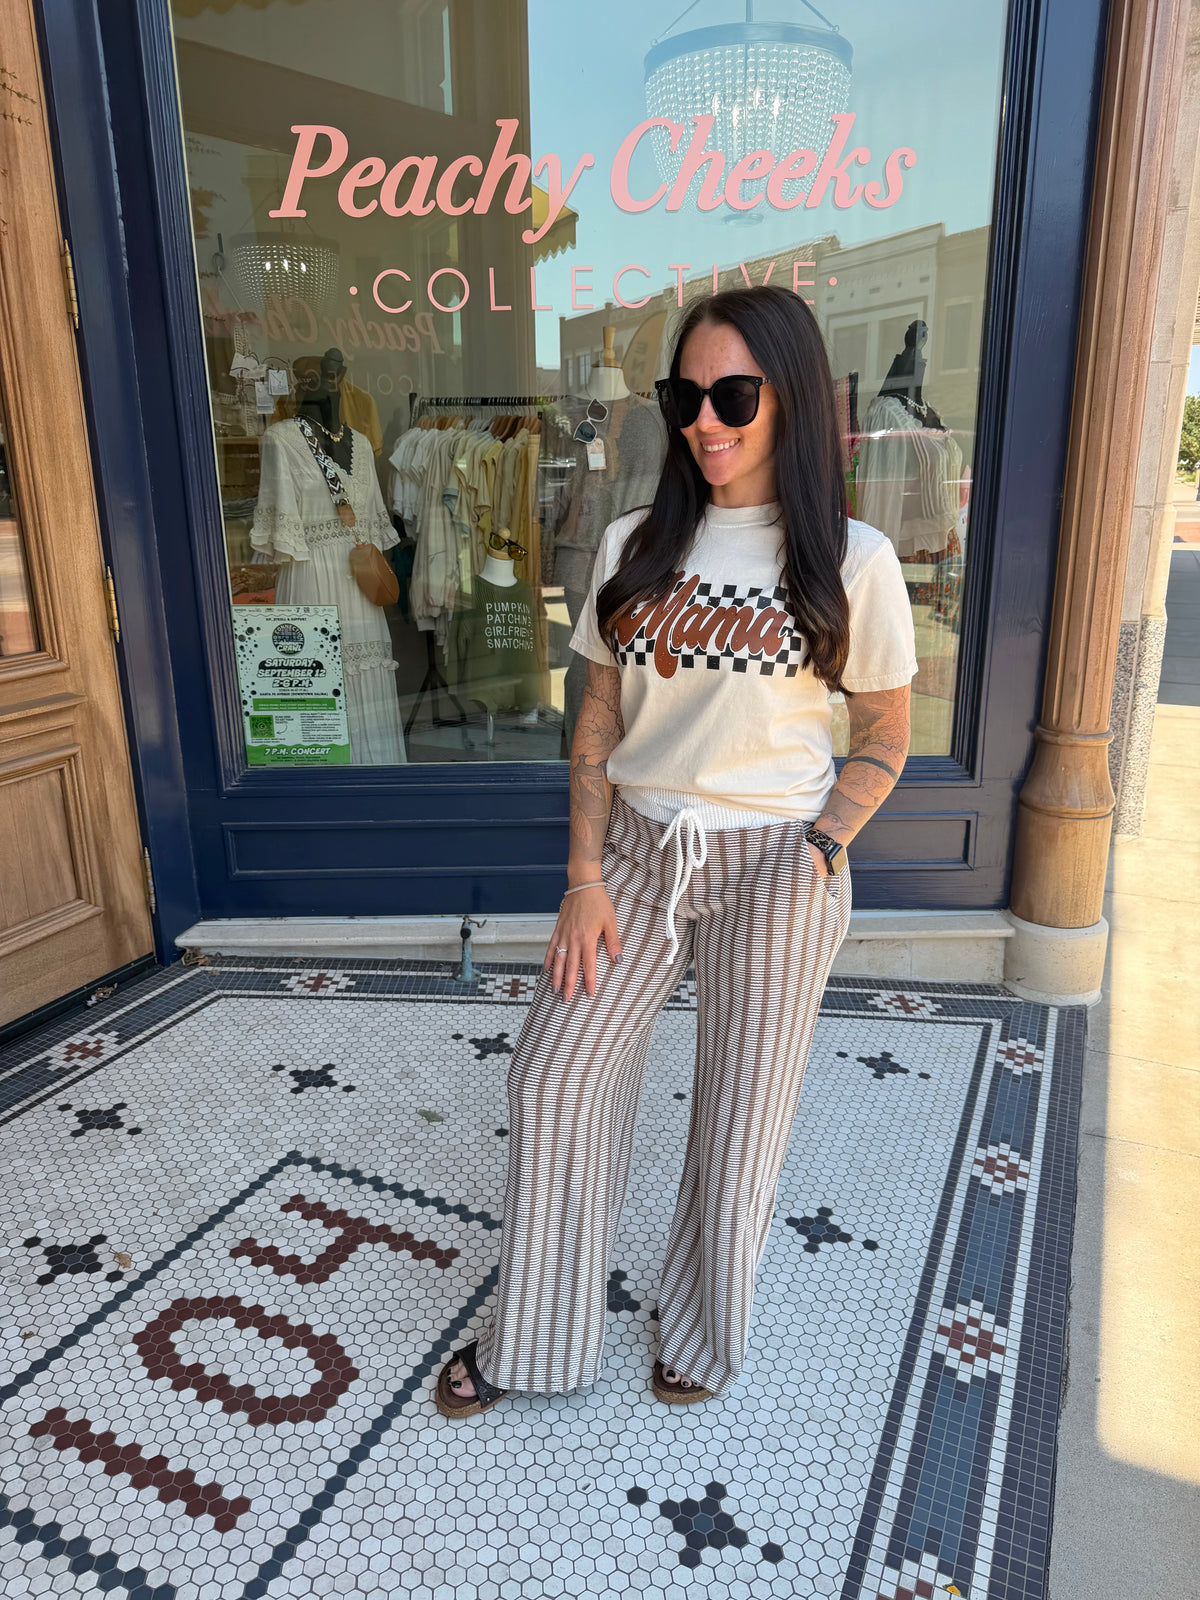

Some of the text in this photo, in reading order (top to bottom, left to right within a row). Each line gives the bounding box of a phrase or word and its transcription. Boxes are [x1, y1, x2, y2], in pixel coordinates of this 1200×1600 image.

[268, 112, 917, 244] Peachy Cheeks
[615, 570, 789, 679] Mama
[257, 668, 326, 678] SEPTEMBER 12
[272, 679, 313, 688] 2-6 P.M.
[290, 747, 330, 755] CONCERT
